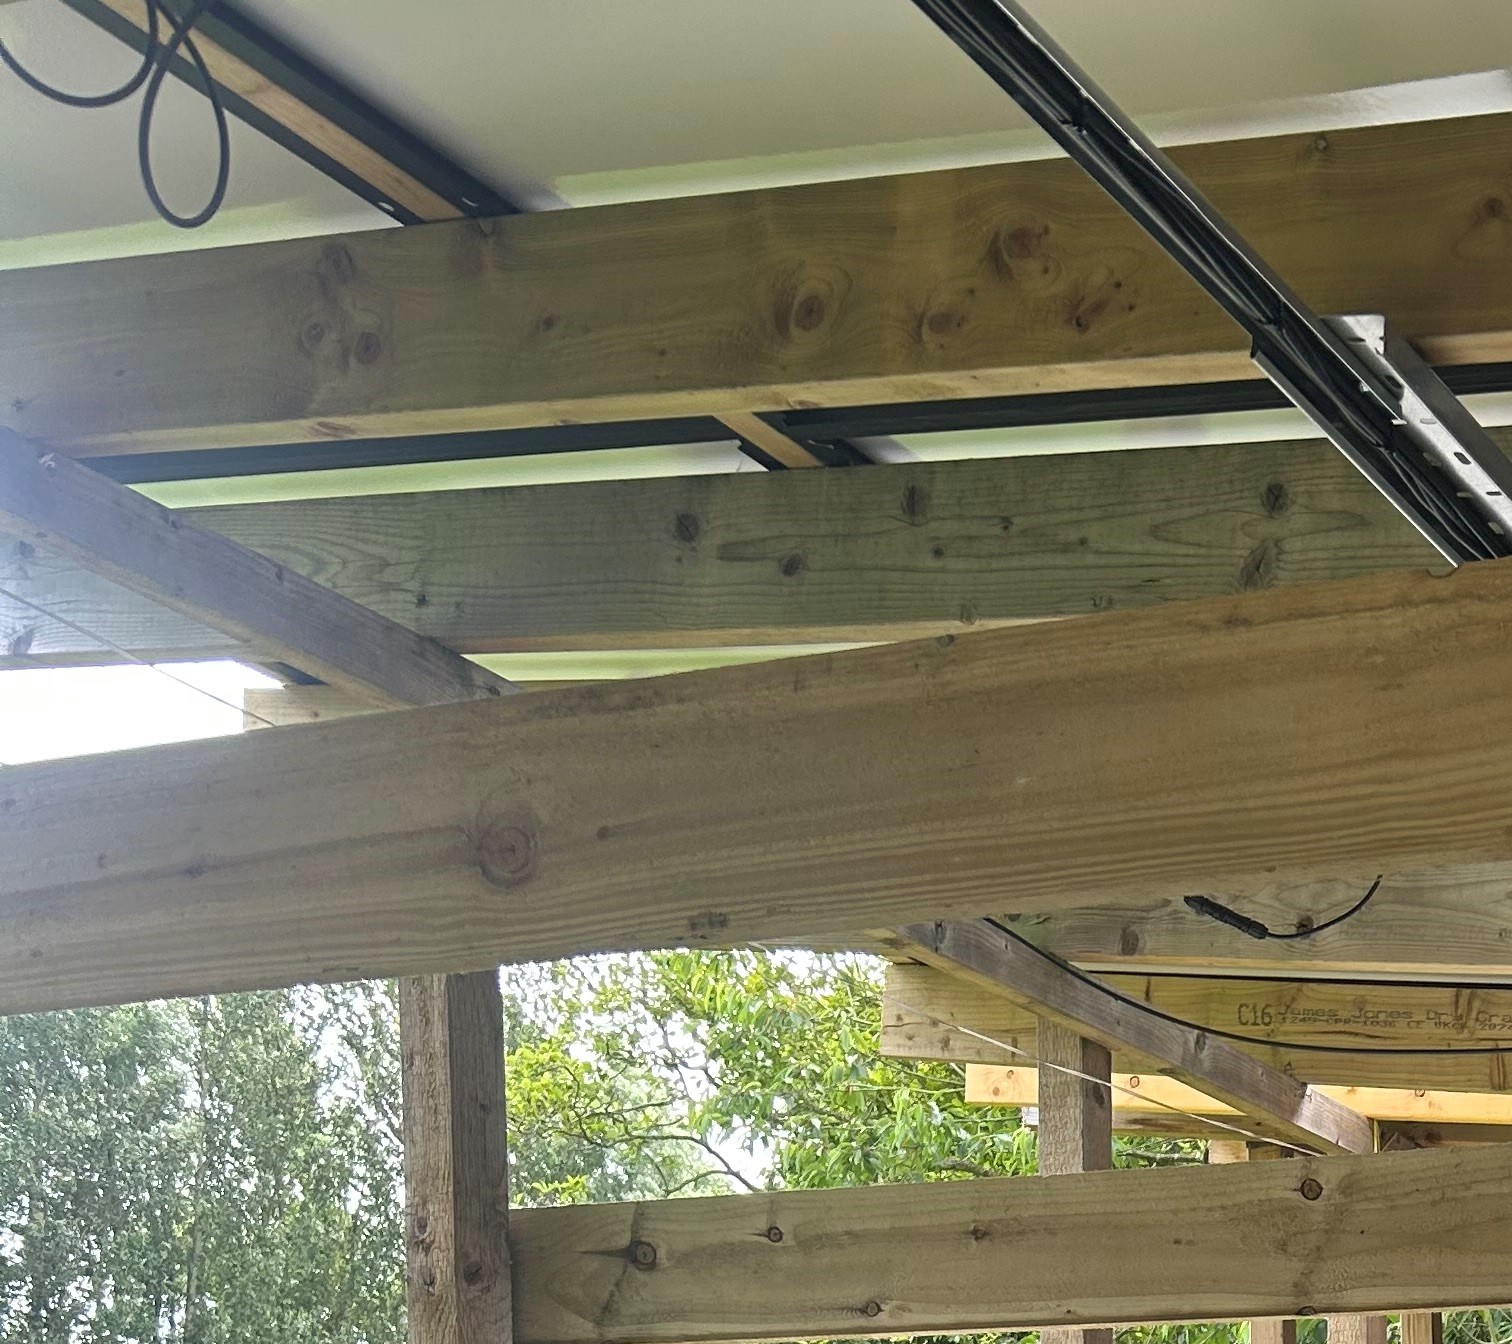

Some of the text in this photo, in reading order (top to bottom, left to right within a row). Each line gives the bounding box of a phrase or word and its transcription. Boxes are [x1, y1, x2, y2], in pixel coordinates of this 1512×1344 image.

[1237, 1003, 1273, 1026] C16
[1278, 1006, 1338, 1018] James
[1351, 1007, 1413, 1019] Jones
